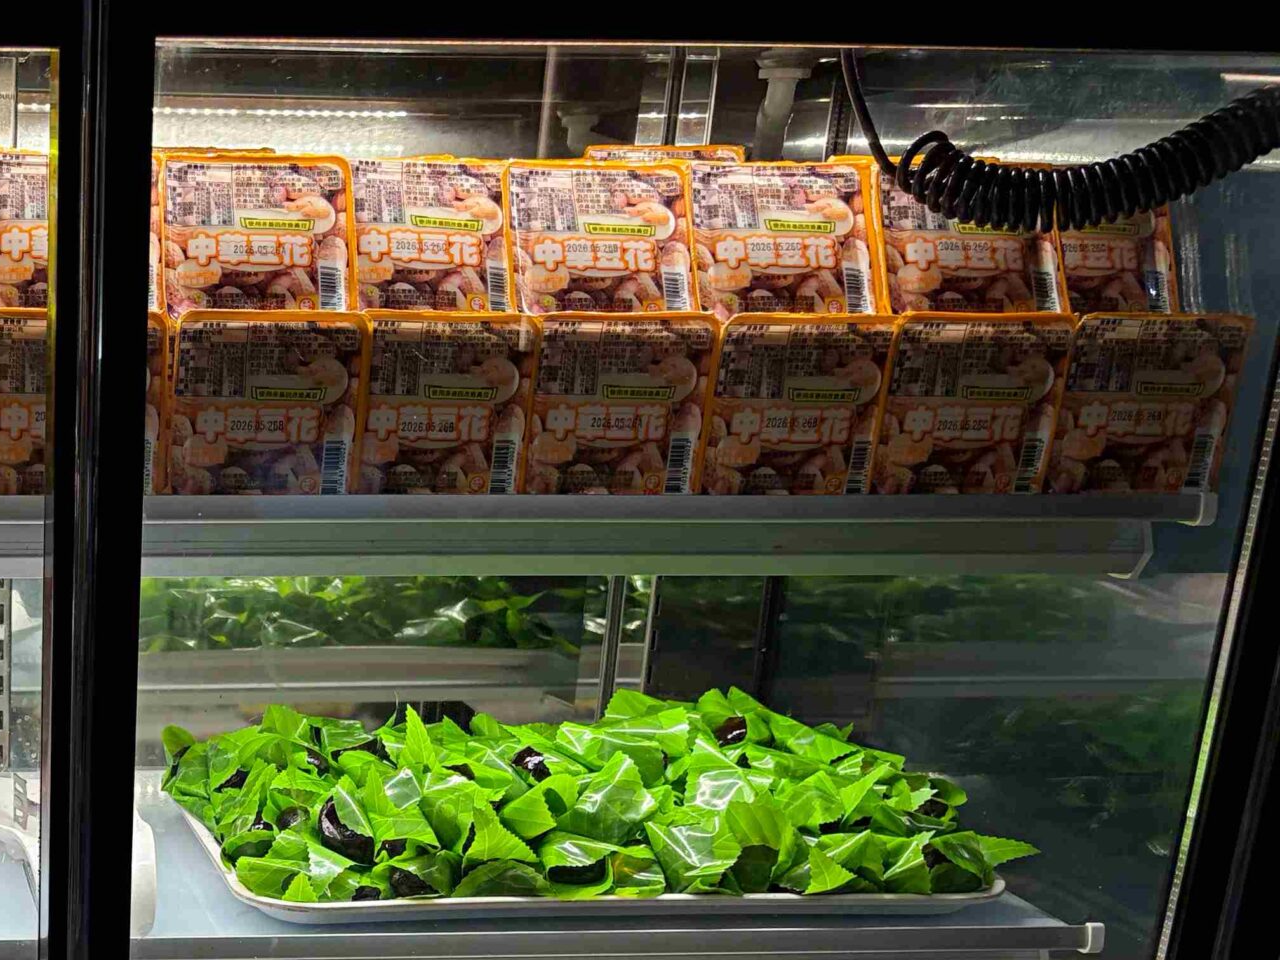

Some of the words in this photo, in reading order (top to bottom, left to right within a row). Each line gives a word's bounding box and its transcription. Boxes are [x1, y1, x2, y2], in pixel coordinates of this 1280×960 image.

[187, 231, 313, 267] 中華豆花
[358, 228, 482, 266] 中華豆花
[534, 236, 657, 272] 中華豆花
[715, 234, 837, 269] 中華豆花
[905, 235, 1025, 272] 中華豆花
[194, 406, 320, 444] 中華豆花
[368, 404, 492, 442] 中華豆花
[545, 403, 671, 441] 中華豆花
[732, 407, 851, 445] 中華豆花
[904, 404, 1023, 442] 中華豆花
[1078, 400, 1193, 437] 中華豆花
